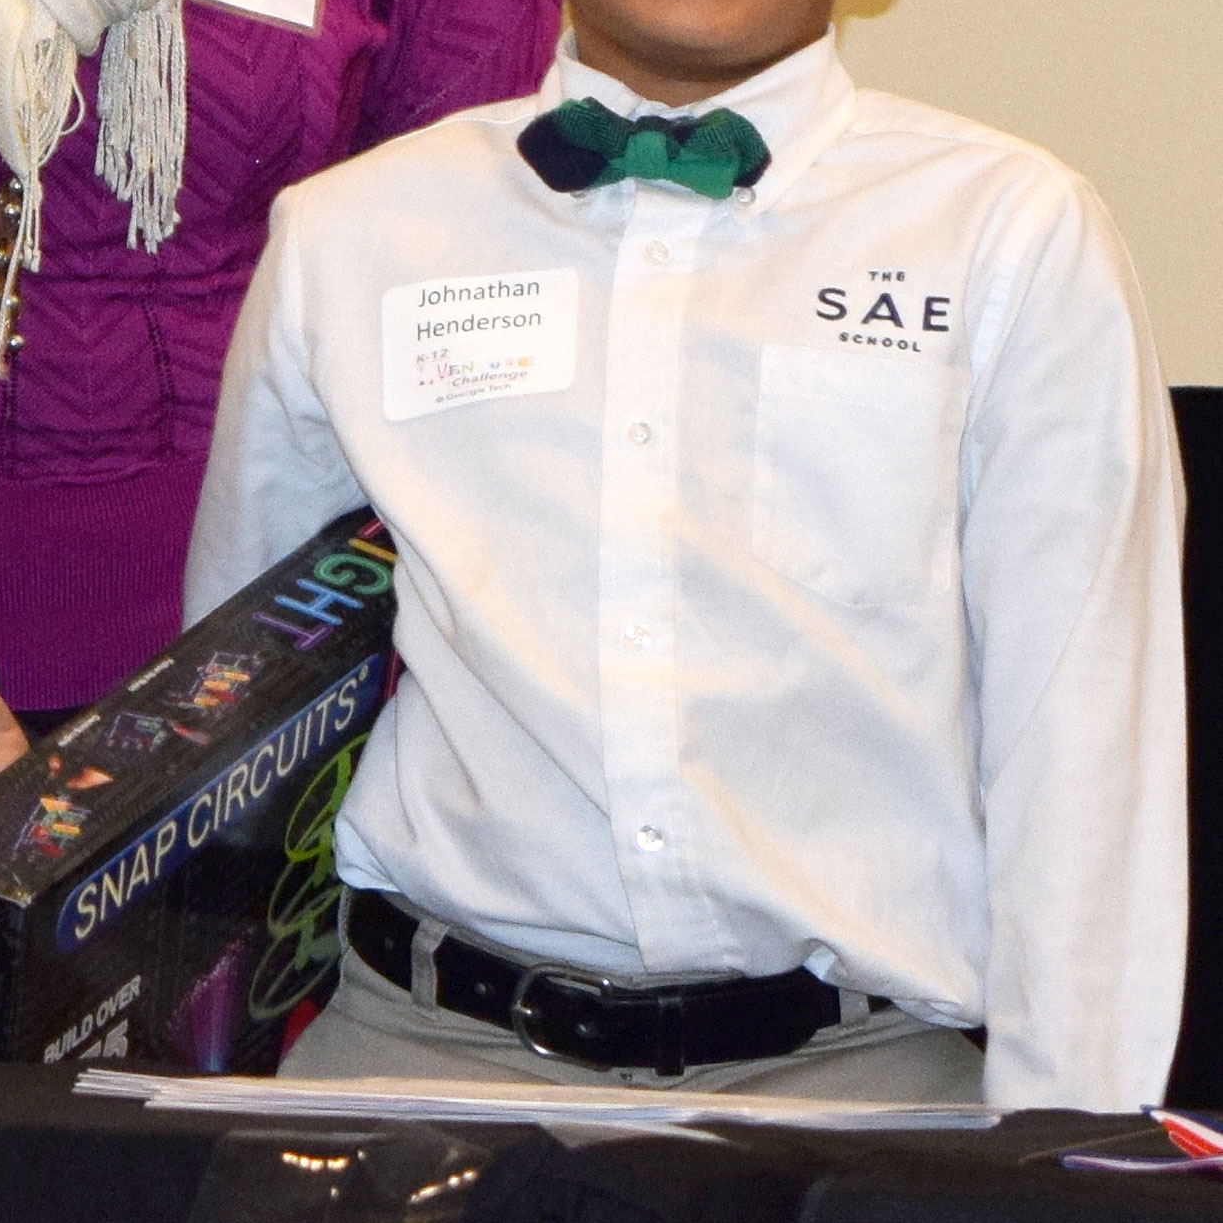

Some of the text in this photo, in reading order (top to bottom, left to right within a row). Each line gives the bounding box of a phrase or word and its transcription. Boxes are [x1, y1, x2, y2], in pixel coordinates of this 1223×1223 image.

[868, 271, 906, 282] THE
[418, 280, 540, 308] Johnathan
[816, 287, 951, 332] SAE
[416, 312, 542, 341] Henderson
[839, 331, 921, 352] SCHOOL
[452, 371, 528, 387] Challenge
[75, 821, 177, 939] SNAP
[44, 1014, 93, 1064] BUILD
[97, 975, 142, 1027] OVER
